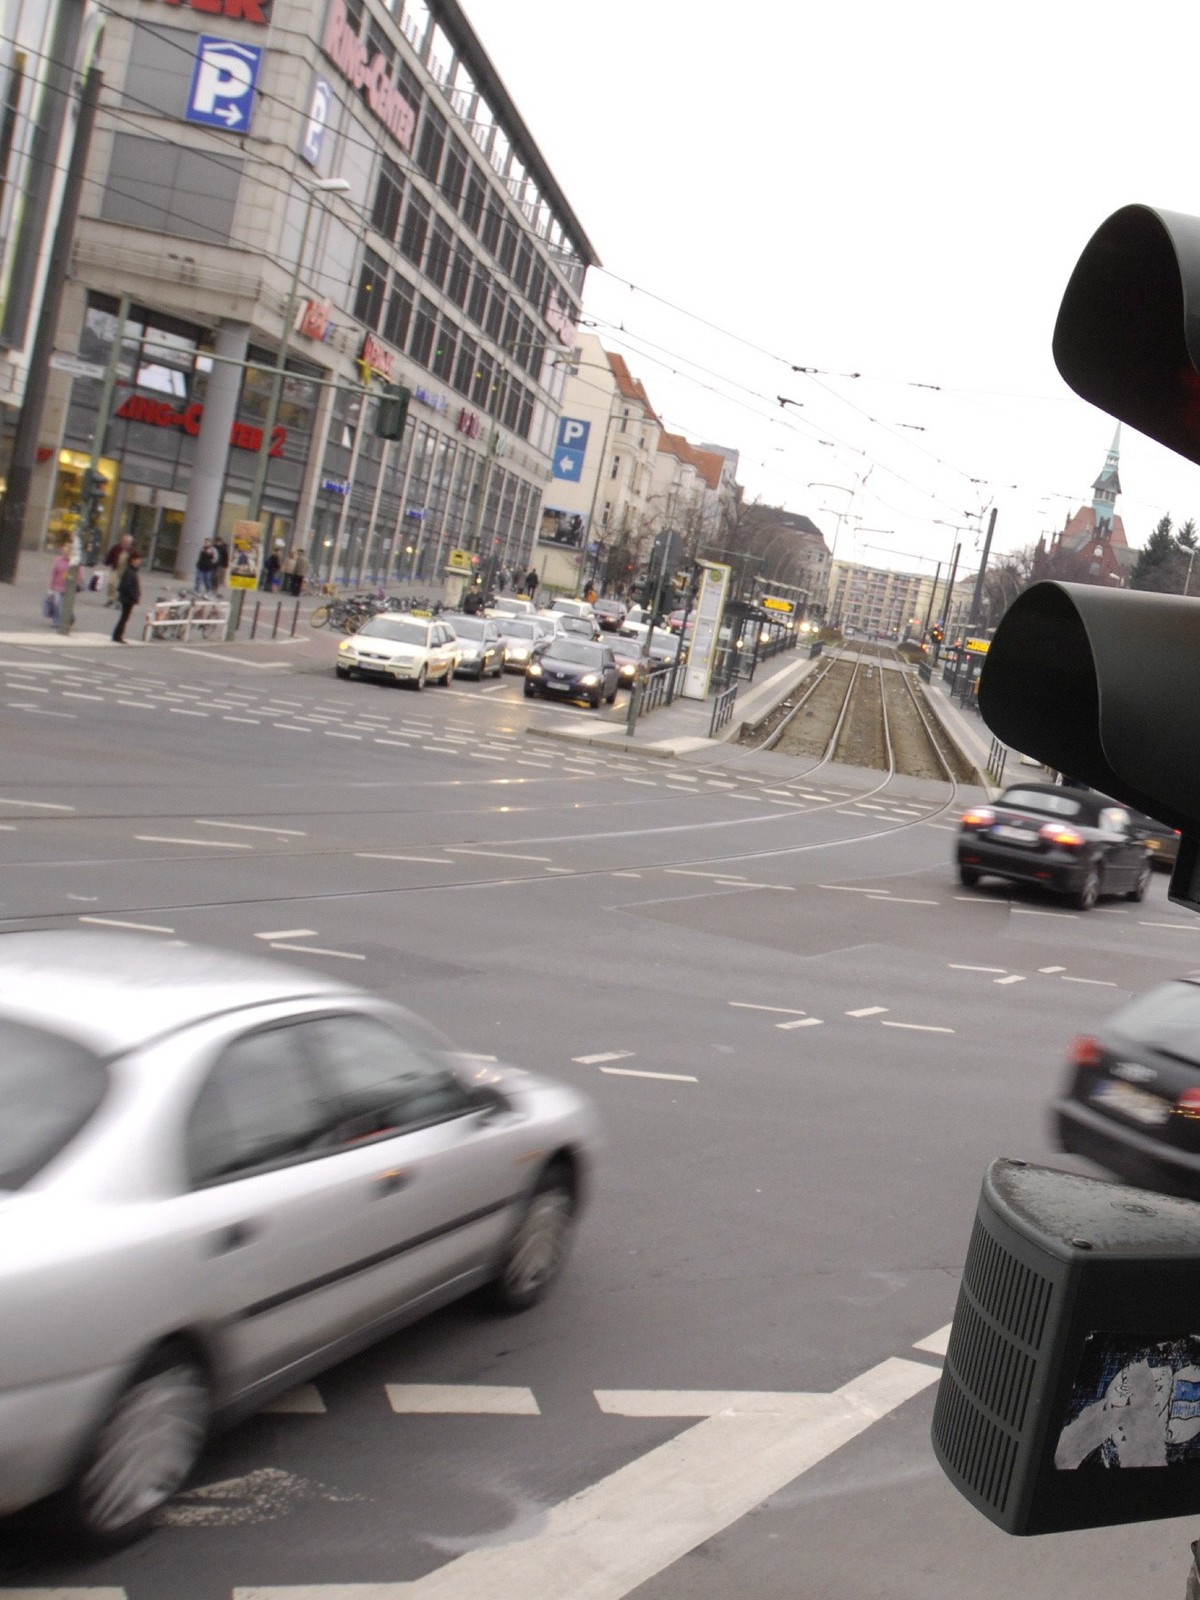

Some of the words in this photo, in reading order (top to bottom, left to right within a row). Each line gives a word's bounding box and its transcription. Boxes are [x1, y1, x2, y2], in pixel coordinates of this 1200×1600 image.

[193, 50, 253, 114] P
[305, 88, 327, 147] P
[562, 420, 584, 445] P
